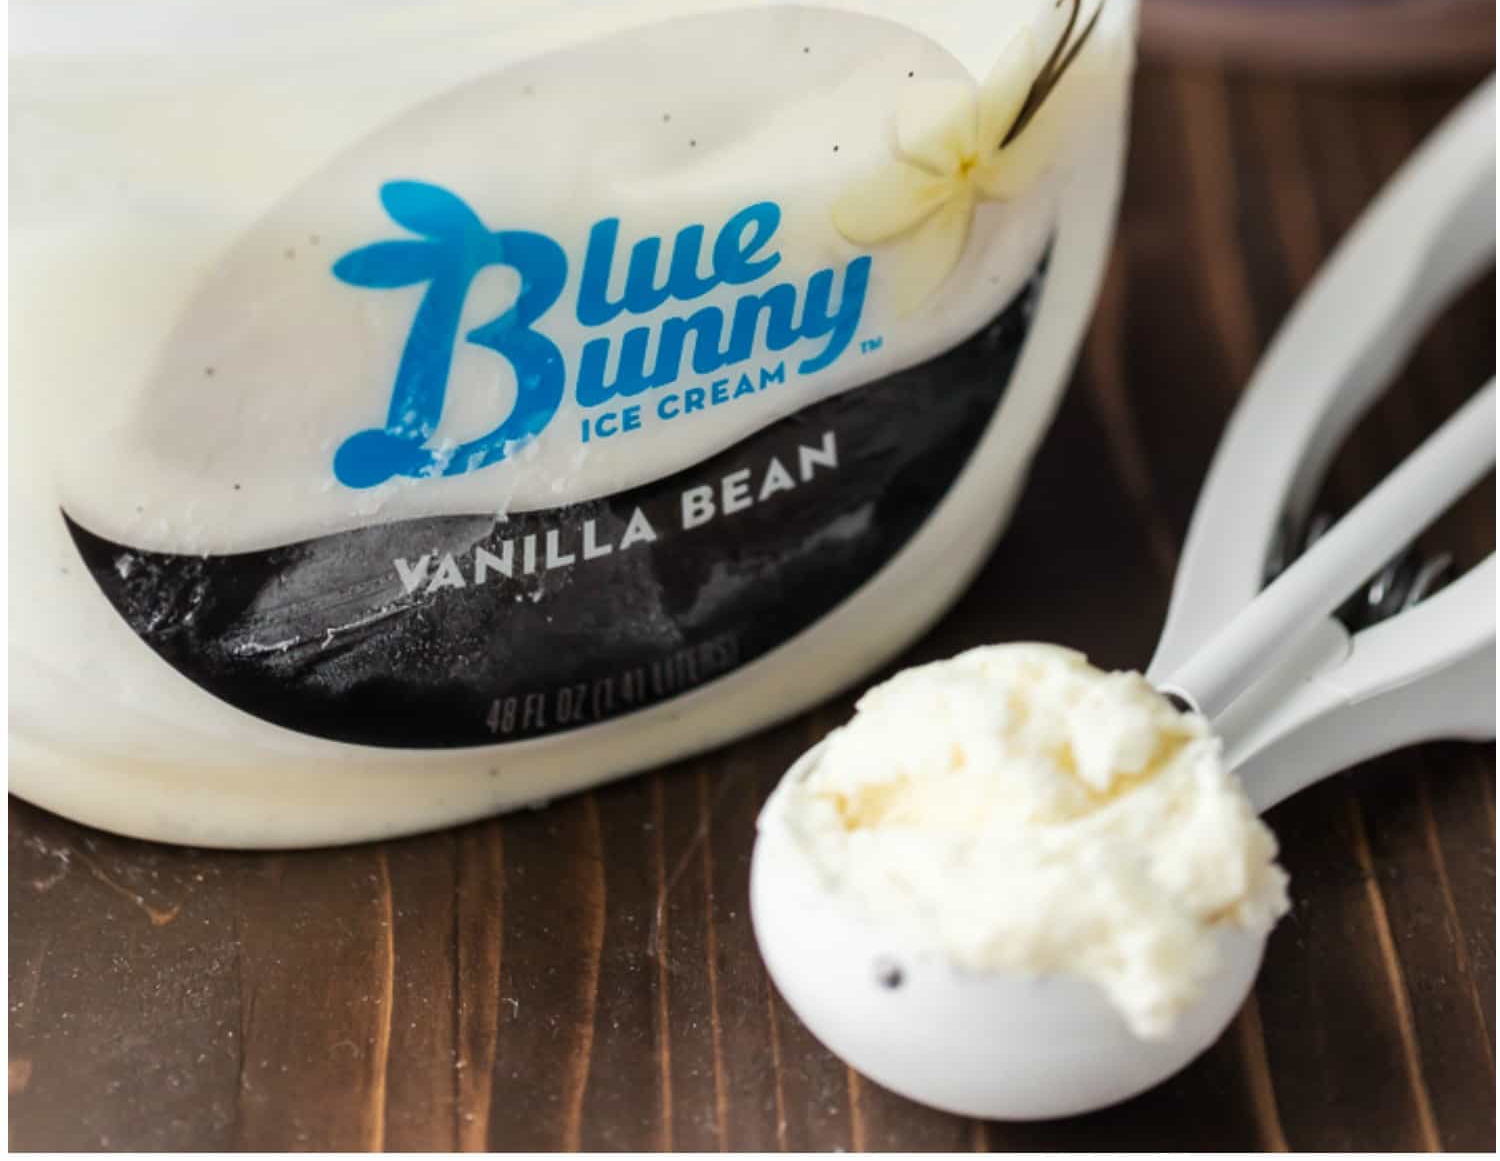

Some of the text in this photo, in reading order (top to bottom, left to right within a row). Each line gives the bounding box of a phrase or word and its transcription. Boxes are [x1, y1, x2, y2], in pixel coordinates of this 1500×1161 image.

[333, 179, 782, 490] Blue
[581, 361, 785, 443] ICE CREAM
[393, 431, 838, 596] VANILLA BEAN
[485, 695, 518, 734] 48
[522, 692, 547, 730] FL
[555, 683, 588, 724] OZ
